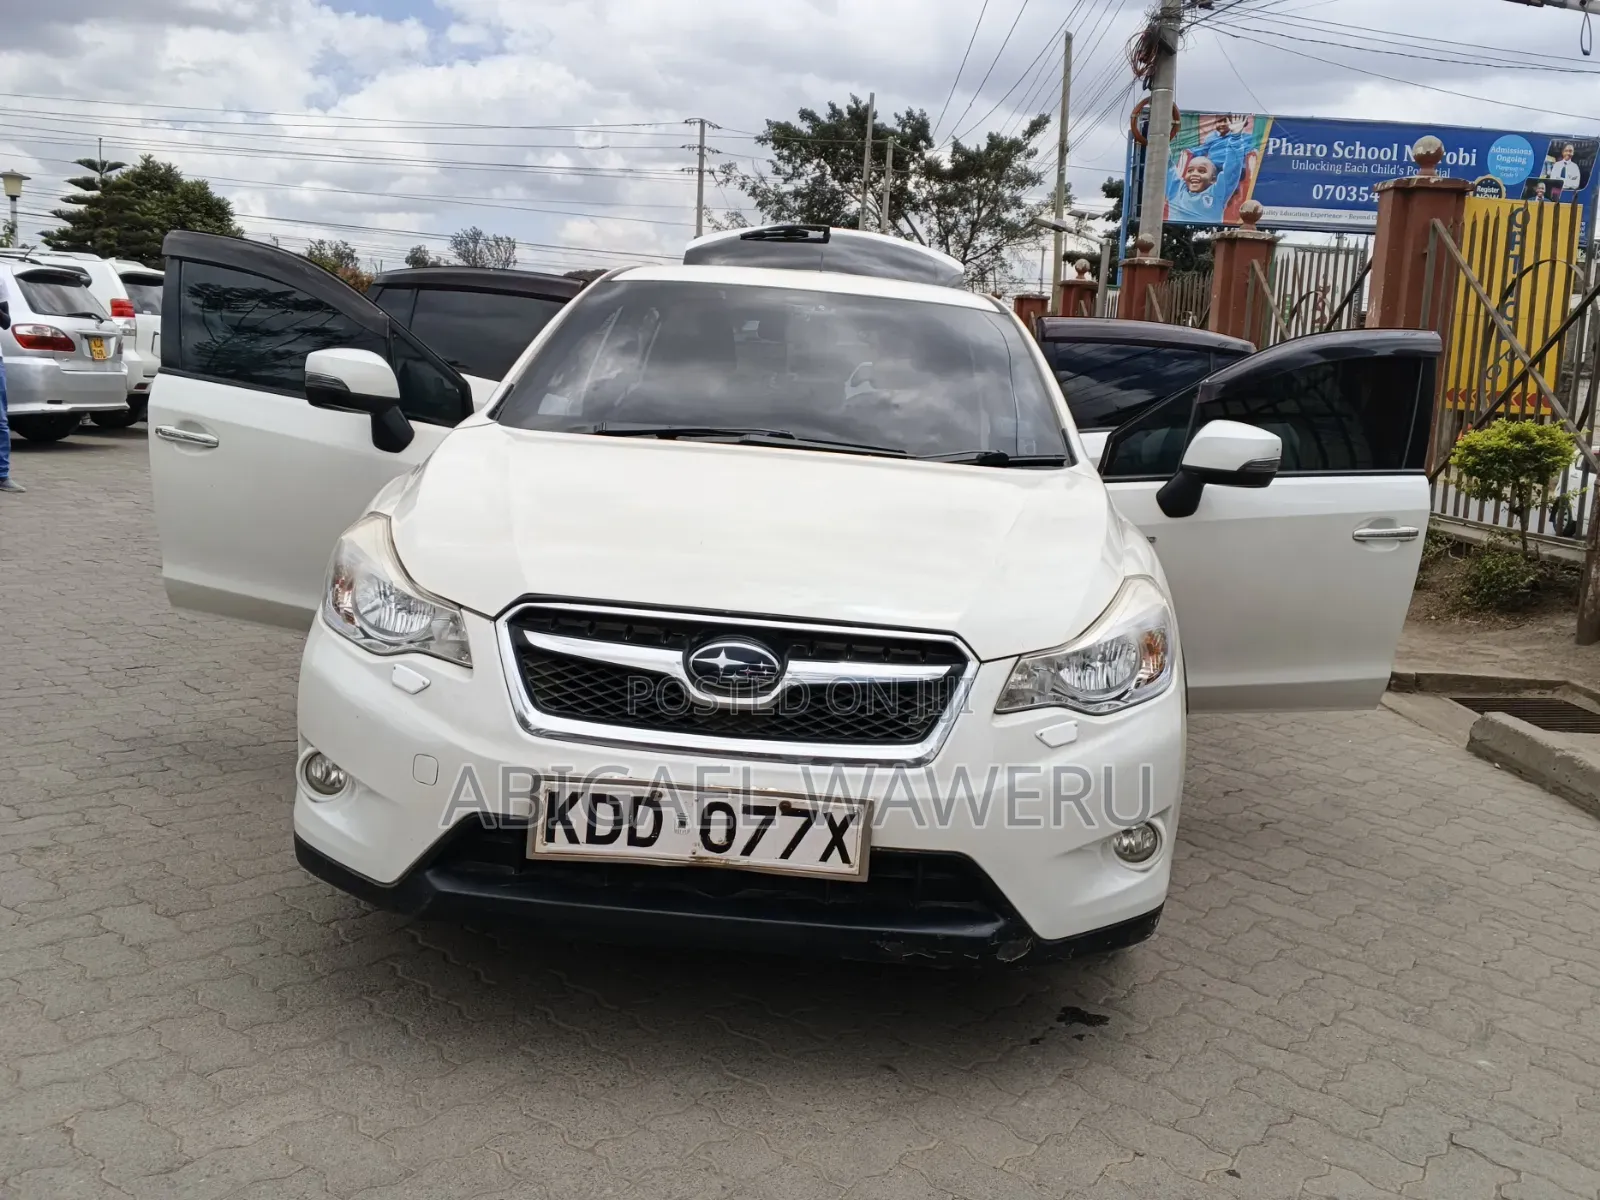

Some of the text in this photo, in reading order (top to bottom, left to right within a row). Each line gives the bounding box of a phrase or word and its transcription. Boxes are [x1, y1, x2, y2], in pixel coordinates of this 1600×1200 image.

[1267, 138, 1476, 166] Pharo School Nrobi
[1491, 146, 1532, 155] Admissions
[1496, 154, 1527, 165] Ongoing
[1292, 160, 1342, 174] Unlocking
[1344, 162, 1368, 173] Each
[1370, 163, 1404, 175] Child's
[1279, 210, 1310, 218] Education
[1310, 211, 1343, 220] Experience
[1348, 213, 1371, 221] Beyond
[545, 790, 857, 864] KDD 077X
